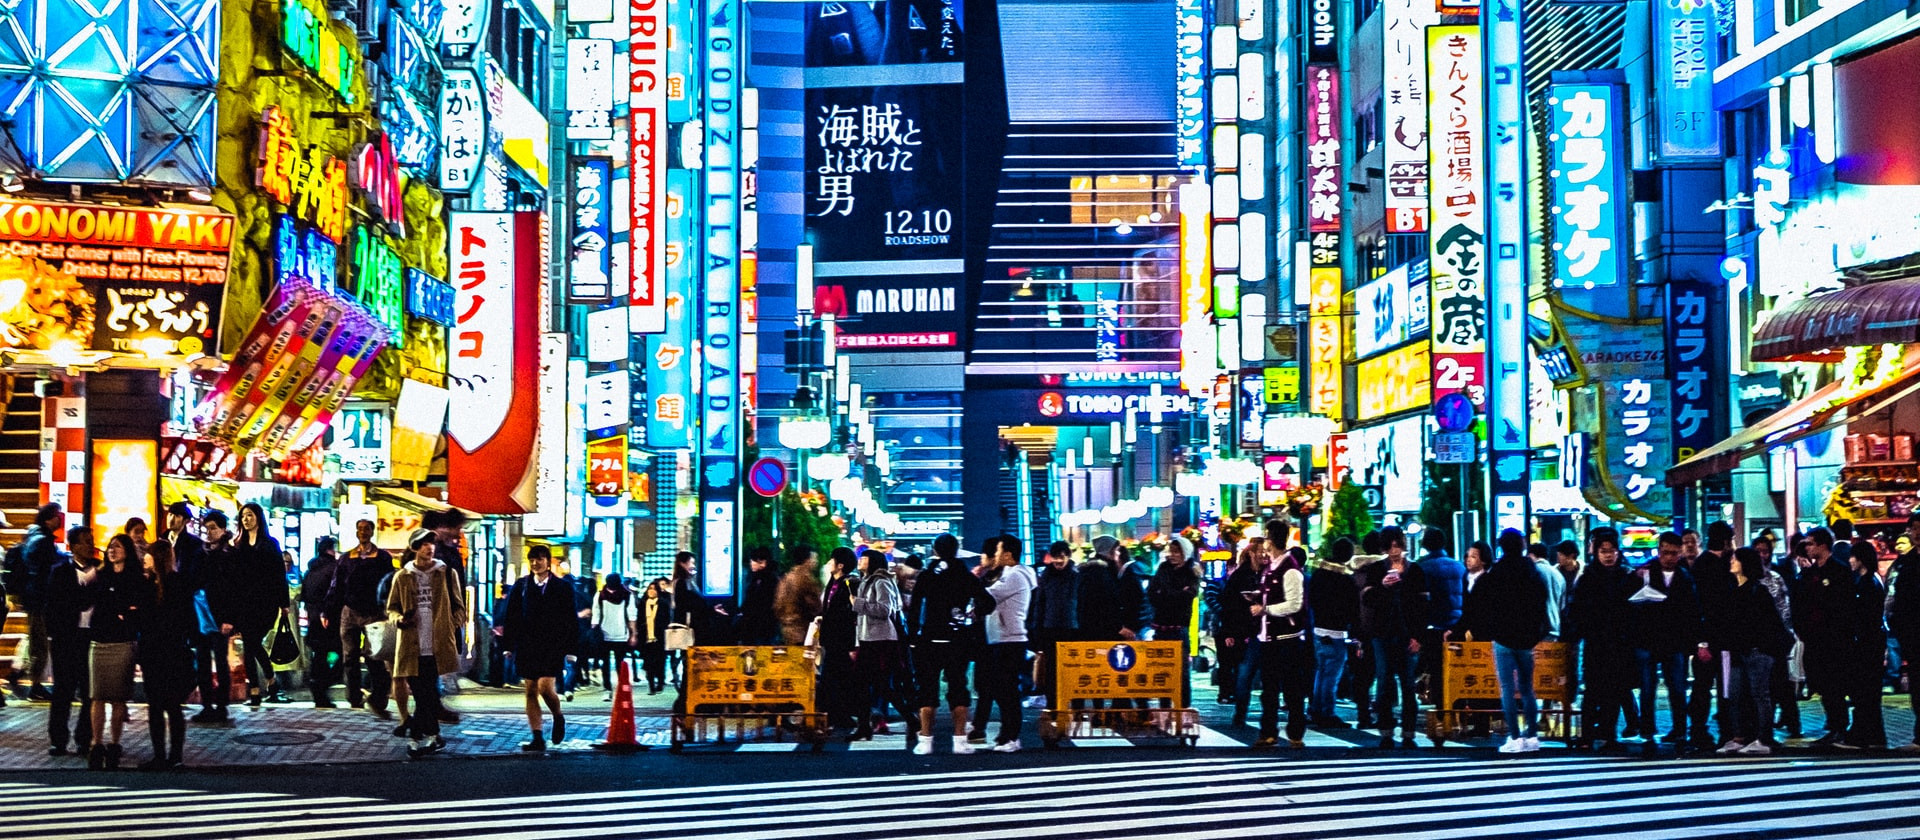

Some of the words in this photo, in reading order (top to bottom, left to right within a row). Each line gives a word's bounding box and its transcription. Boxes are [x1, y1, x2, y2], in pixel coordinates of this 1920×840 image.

[940, 0, 955, 56] 変えた。
[448, 44, 469, 57] 1F
[1690, 19, 1706, 71] IDOL
[817, 103, 922, 147] 海賊と
[1447, 35, 1472, 182] きんくら酒場
[1674, 110, 1706, 131] 5F
[710, 37, 732, 269] GODZILLA
[818, 147, 914, 174] よばれた
[448, 168, 470, 182] B1
[1308, 138, 1341, 222] 甘太郎
[1561, 91, 1611, 278] カラオケ
[816, 175, 855, 216] 男
[147, 212, 232, 247] YAKI
[884, 209, 952, 234] 12.10
[1395, 207, 1429, 231] B1
[885, 235, 950, 245] ROADSHOW
[1313, 233, 1339, 248] 4F
[1313, 249, 1339, 264] 3F
[63, 260, 107, 277] Drinks
[109, 263, 130, 279] for
[130, 265, 141, 279] 2
[142, 265, 181, 281] hours
[66, 245, 110, 260] dinner
[112, 247, 141, 262] with
[143, 249, 227, 269] Free-Flowing
[457, 226, 487, 359] トラノコ
[856, 287, 956, 313] MARUHAN
[1436, 222, 1485, 346] 金の蔵
[709, 301, 731, 412] ROAD
[1436, 357, 1476, 389] 2F
[1675, 290, 1709, 439] カラオケ
[1066, 394, 1123, 413] TOHO
[1622, 378, 1657, 500] カラオケ
